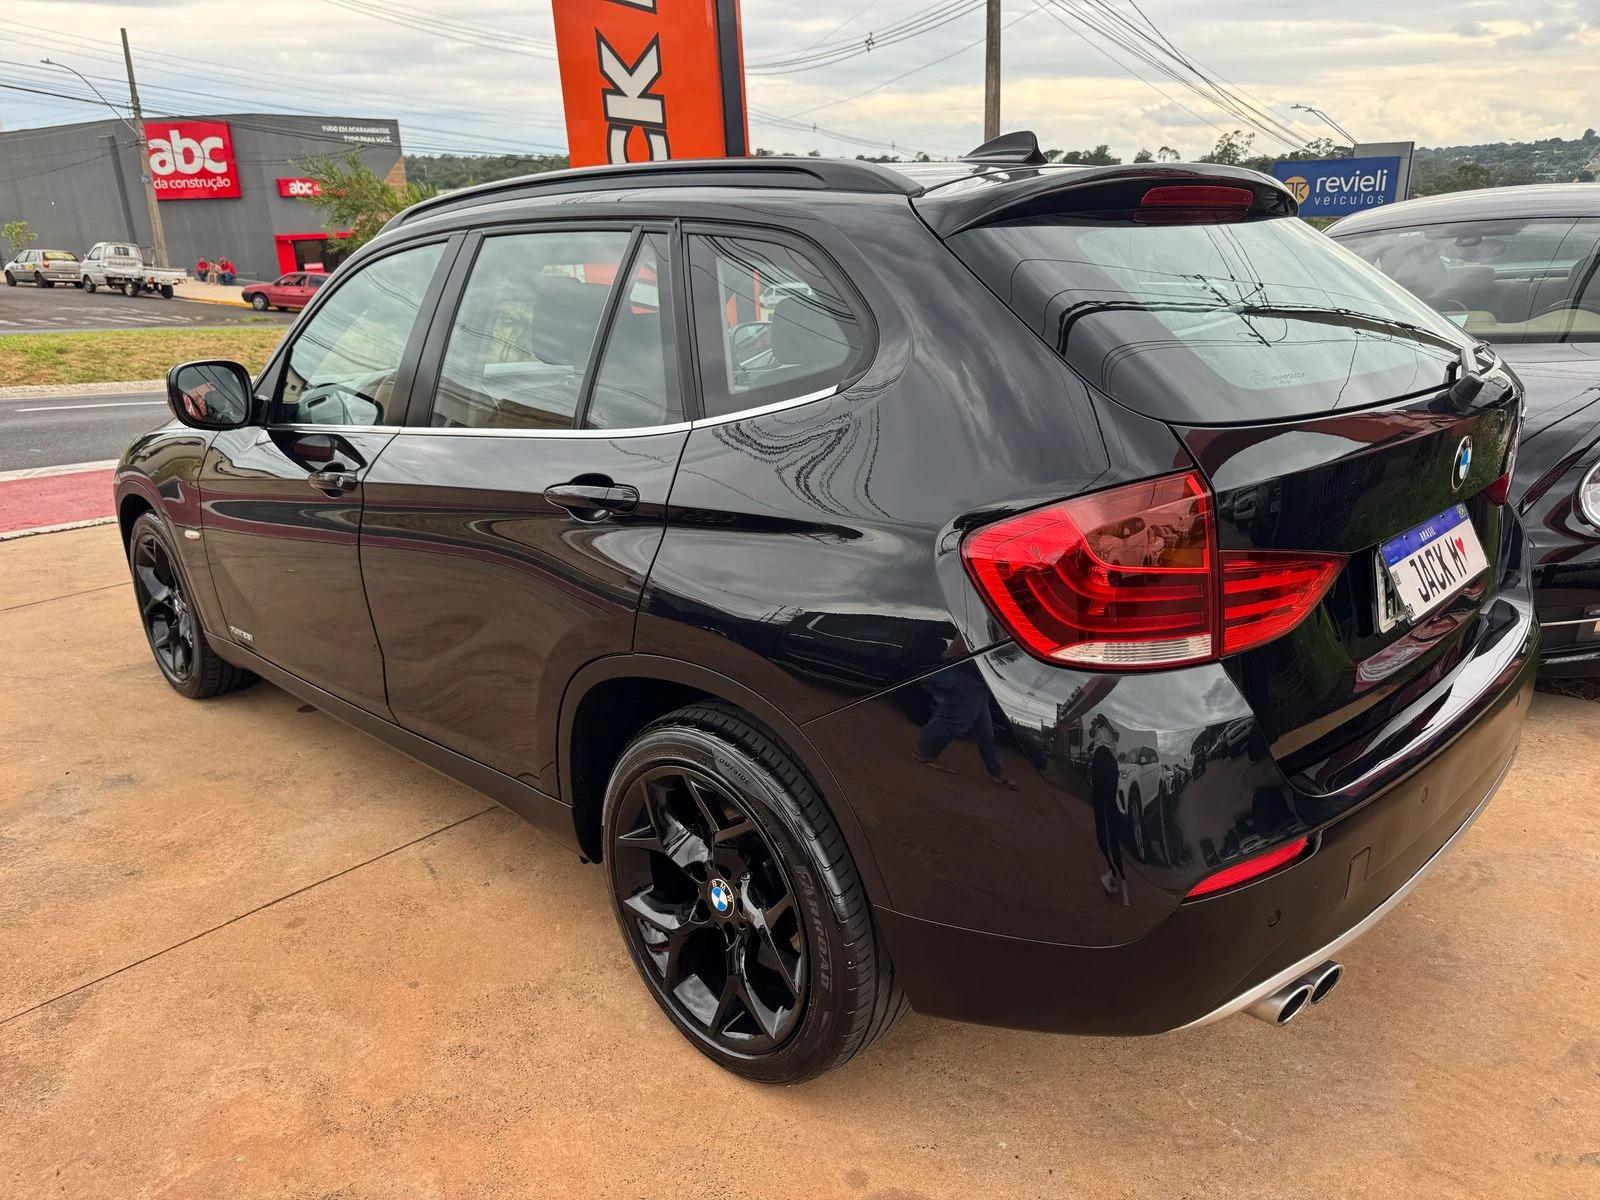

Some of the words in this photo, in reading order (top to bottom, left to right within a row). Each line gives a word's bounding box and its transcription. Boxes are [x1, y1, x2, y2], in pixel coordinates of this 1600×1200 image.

[148, 129, 228, 176] abc
[153, 178, 168, 190] da
[169, 176, 231, 191] construção
[289, 180, 313, 195] abc
[1315, 169, 1388, 193] revieli
[1419, 526, 1437, 542] BRASIL
[1408, 543, 1457, 603] JACK
[1444, 536, 1468, 578] M
[718, 756, 751, 787] OUTSIDE
